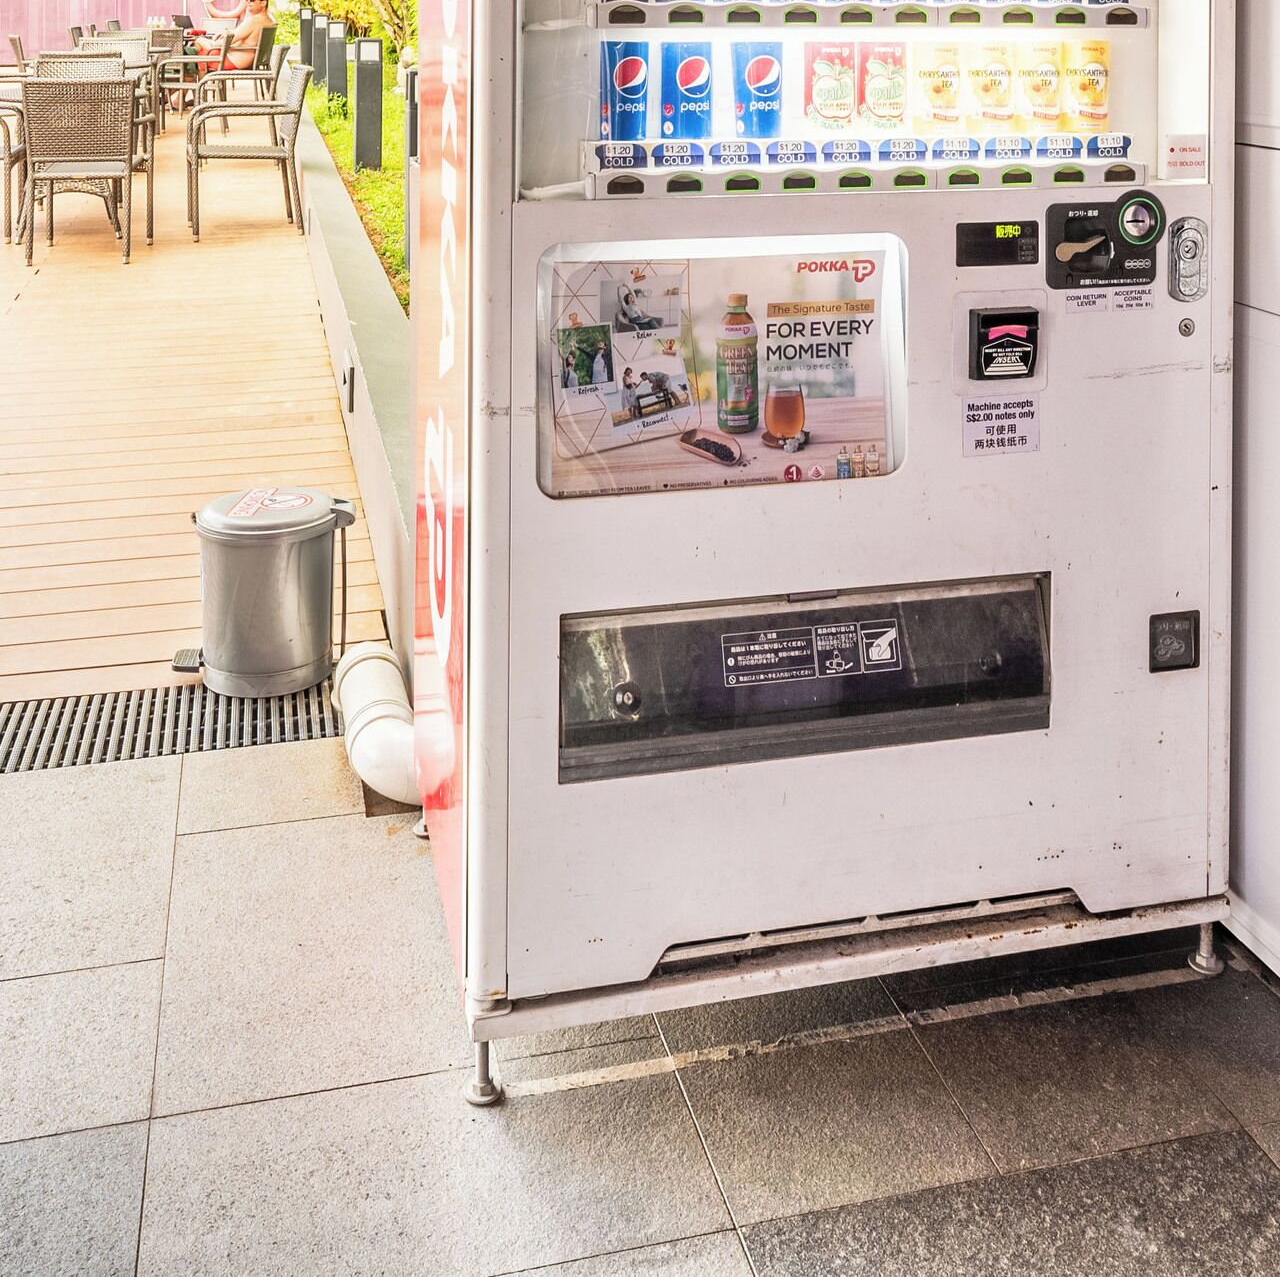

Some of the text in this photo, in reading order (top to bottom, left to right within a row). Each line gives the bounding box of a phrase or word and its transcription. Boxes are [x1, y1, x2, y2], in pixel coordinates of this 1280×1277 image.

[941, 80, 953, 88] TEA
[990, 79, 1002, 87] TEA
[1040, 79, 1053, 87] TEA
[1087, 78, 1100, 87] TEA
[616, 101, 646, 114] pepsi
[680, 101, 710, 114] pepsi
[750, 99, 780, 113] pepsi
[835, 141, 857, 151] $1.20
[892, 140, 914, 150] $1.20
[944, 139, 968, 149] $1.10
[998, 138, 1020, 149] $1.10
[1049, 138, 1071, 147] $1.10
[1100, 136, 1122, 146] $1.10
[606, 145, 631, 156] $1.20
[665, 144, 688, 154] $1.20
[722, 143, 745, 153] $1.20
[778, 142, 802, 152] $1.20
[1098, 147, 1123, 157] COLD
[832, 153, 860, 163] COLD
[890, 151, 917, 161] COLD
[942, 150, 970, 160] COLD
[995, 148, 1022, 159] COLD
[1047, 148, 1073, 158] COLD
[604, 156, 634, 167] COLD
[662, 155, 692, 166] COLD
[720, 154, 749, 164] COLD
[777, 153, 805, 164] COLD
[995, 224, 1022, 239] 販売中
[797, 260, 850, 274] POKKA
[772, 302, 871, 316] The Signature Taste
[766, 319, 875, 339] FOR EVERY
[636, 332, 653, 340] Relax
[720, 347, 753, 360] GREEN
[766, 341, 853, 362] MOMENT
[993, 356, 1021, 364] INSERT
[577, 386, 600, 396] Refresh
[967, 399, 1034, 413] Machine accepts
[641, 414, 670, 428] Reconnect
[966, 410, 1035, 423] S$2.00 notes only
[985, 424, 1017, 436] 可使用
[974, 435, 1028, 450] 两块钱纸币
